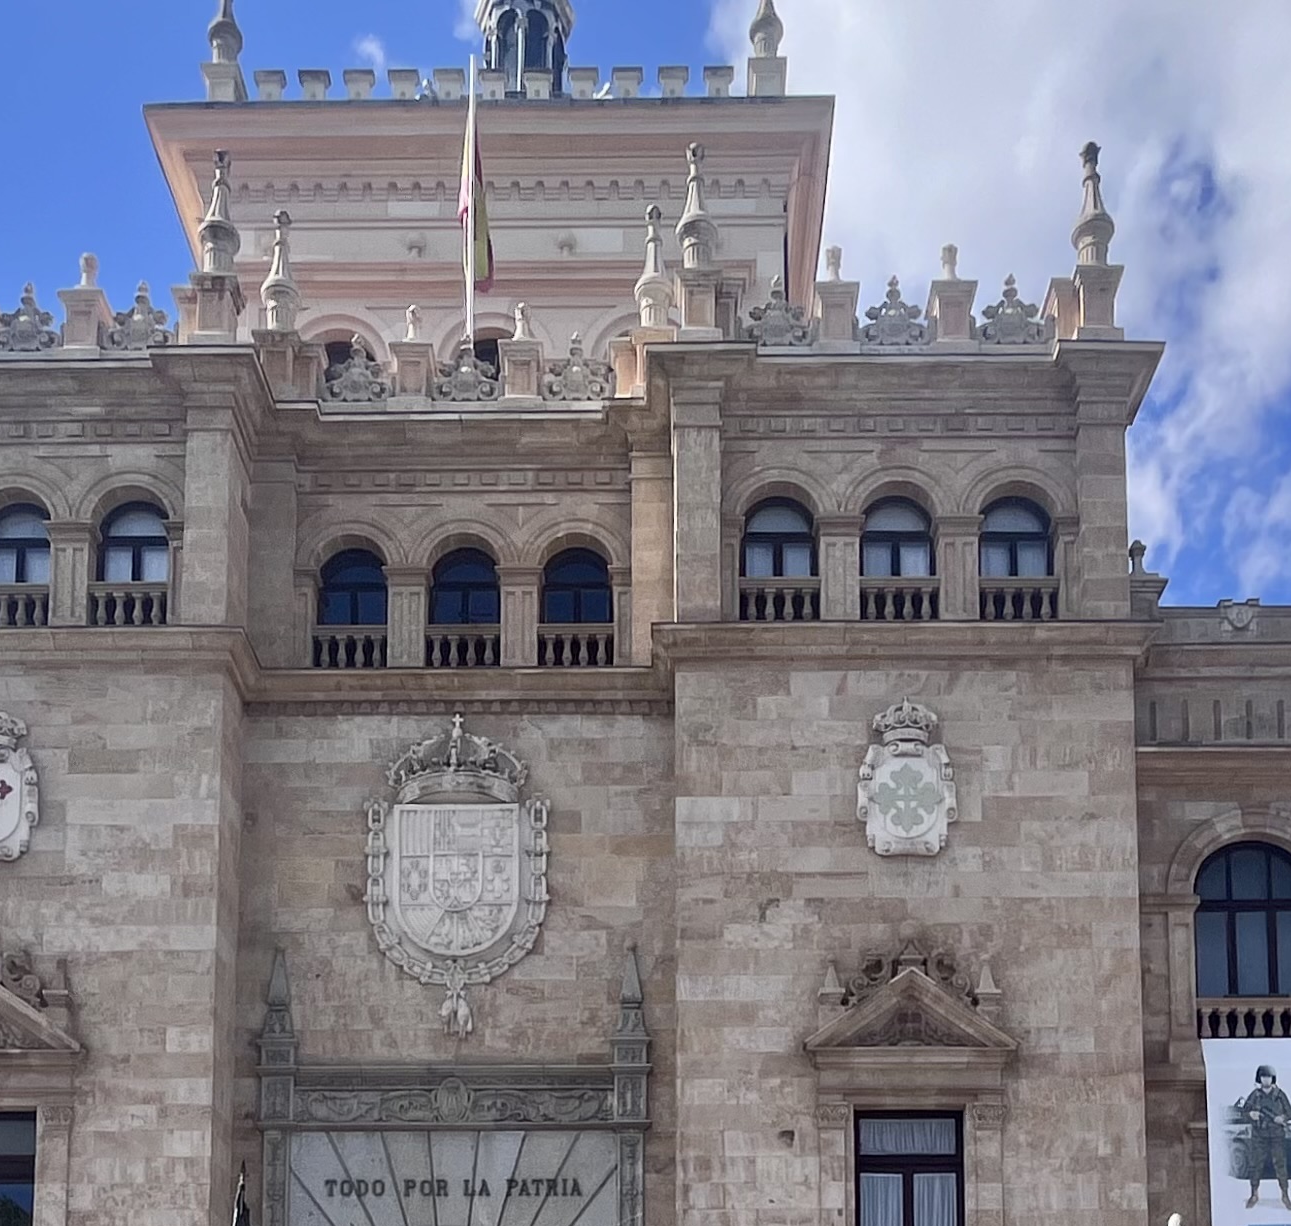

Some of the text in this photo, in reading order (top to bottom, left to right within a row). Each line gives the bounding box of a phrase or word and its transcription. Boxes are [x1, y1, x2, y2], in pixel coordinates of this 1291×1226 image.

[324, 1178, 583, 1198] TODO POR LA PATRIA
